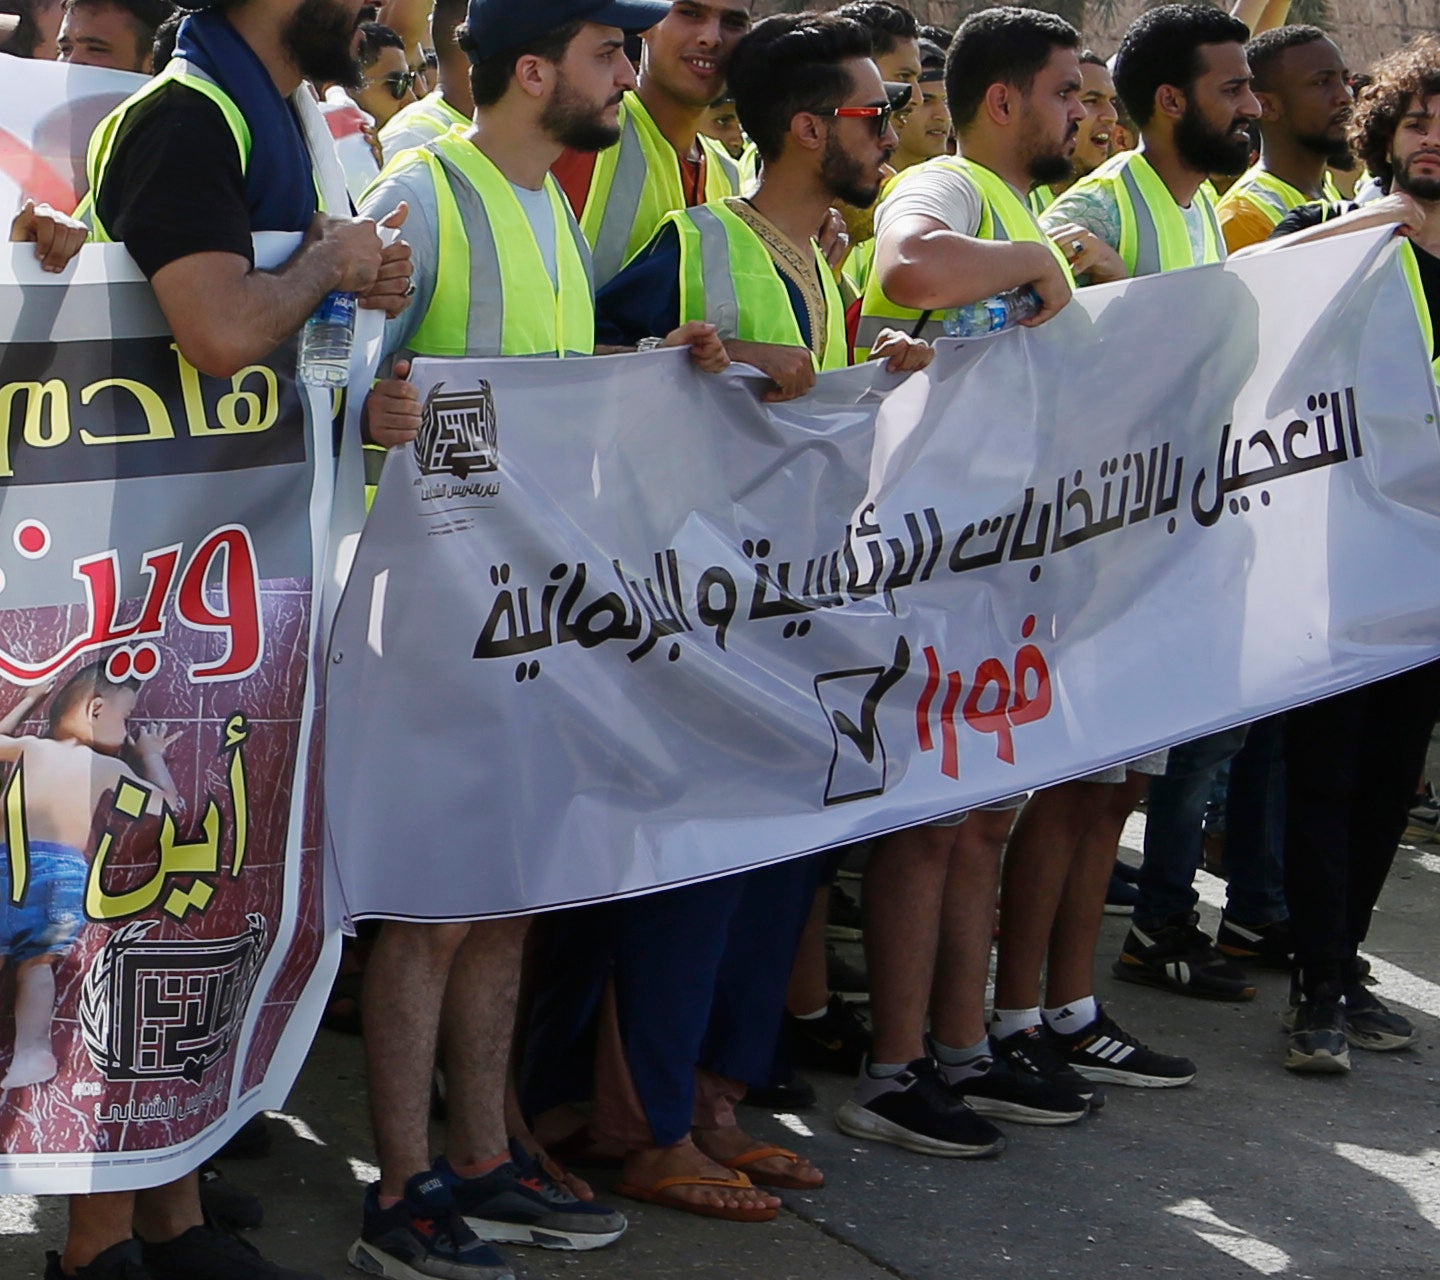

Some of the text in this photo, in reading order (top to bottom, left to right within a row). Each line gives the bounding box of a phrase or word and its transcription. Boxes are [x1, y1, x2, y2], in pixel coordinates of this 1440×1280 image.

[948, 442, 1185, 583] بالانتخابات
[1191, 387, 1364, 528] التعجيل
[472, 548, 694, 684] البرلمانية
[916, 614, 1052, 781] فورا
[83, 713, 250, 926] أين
